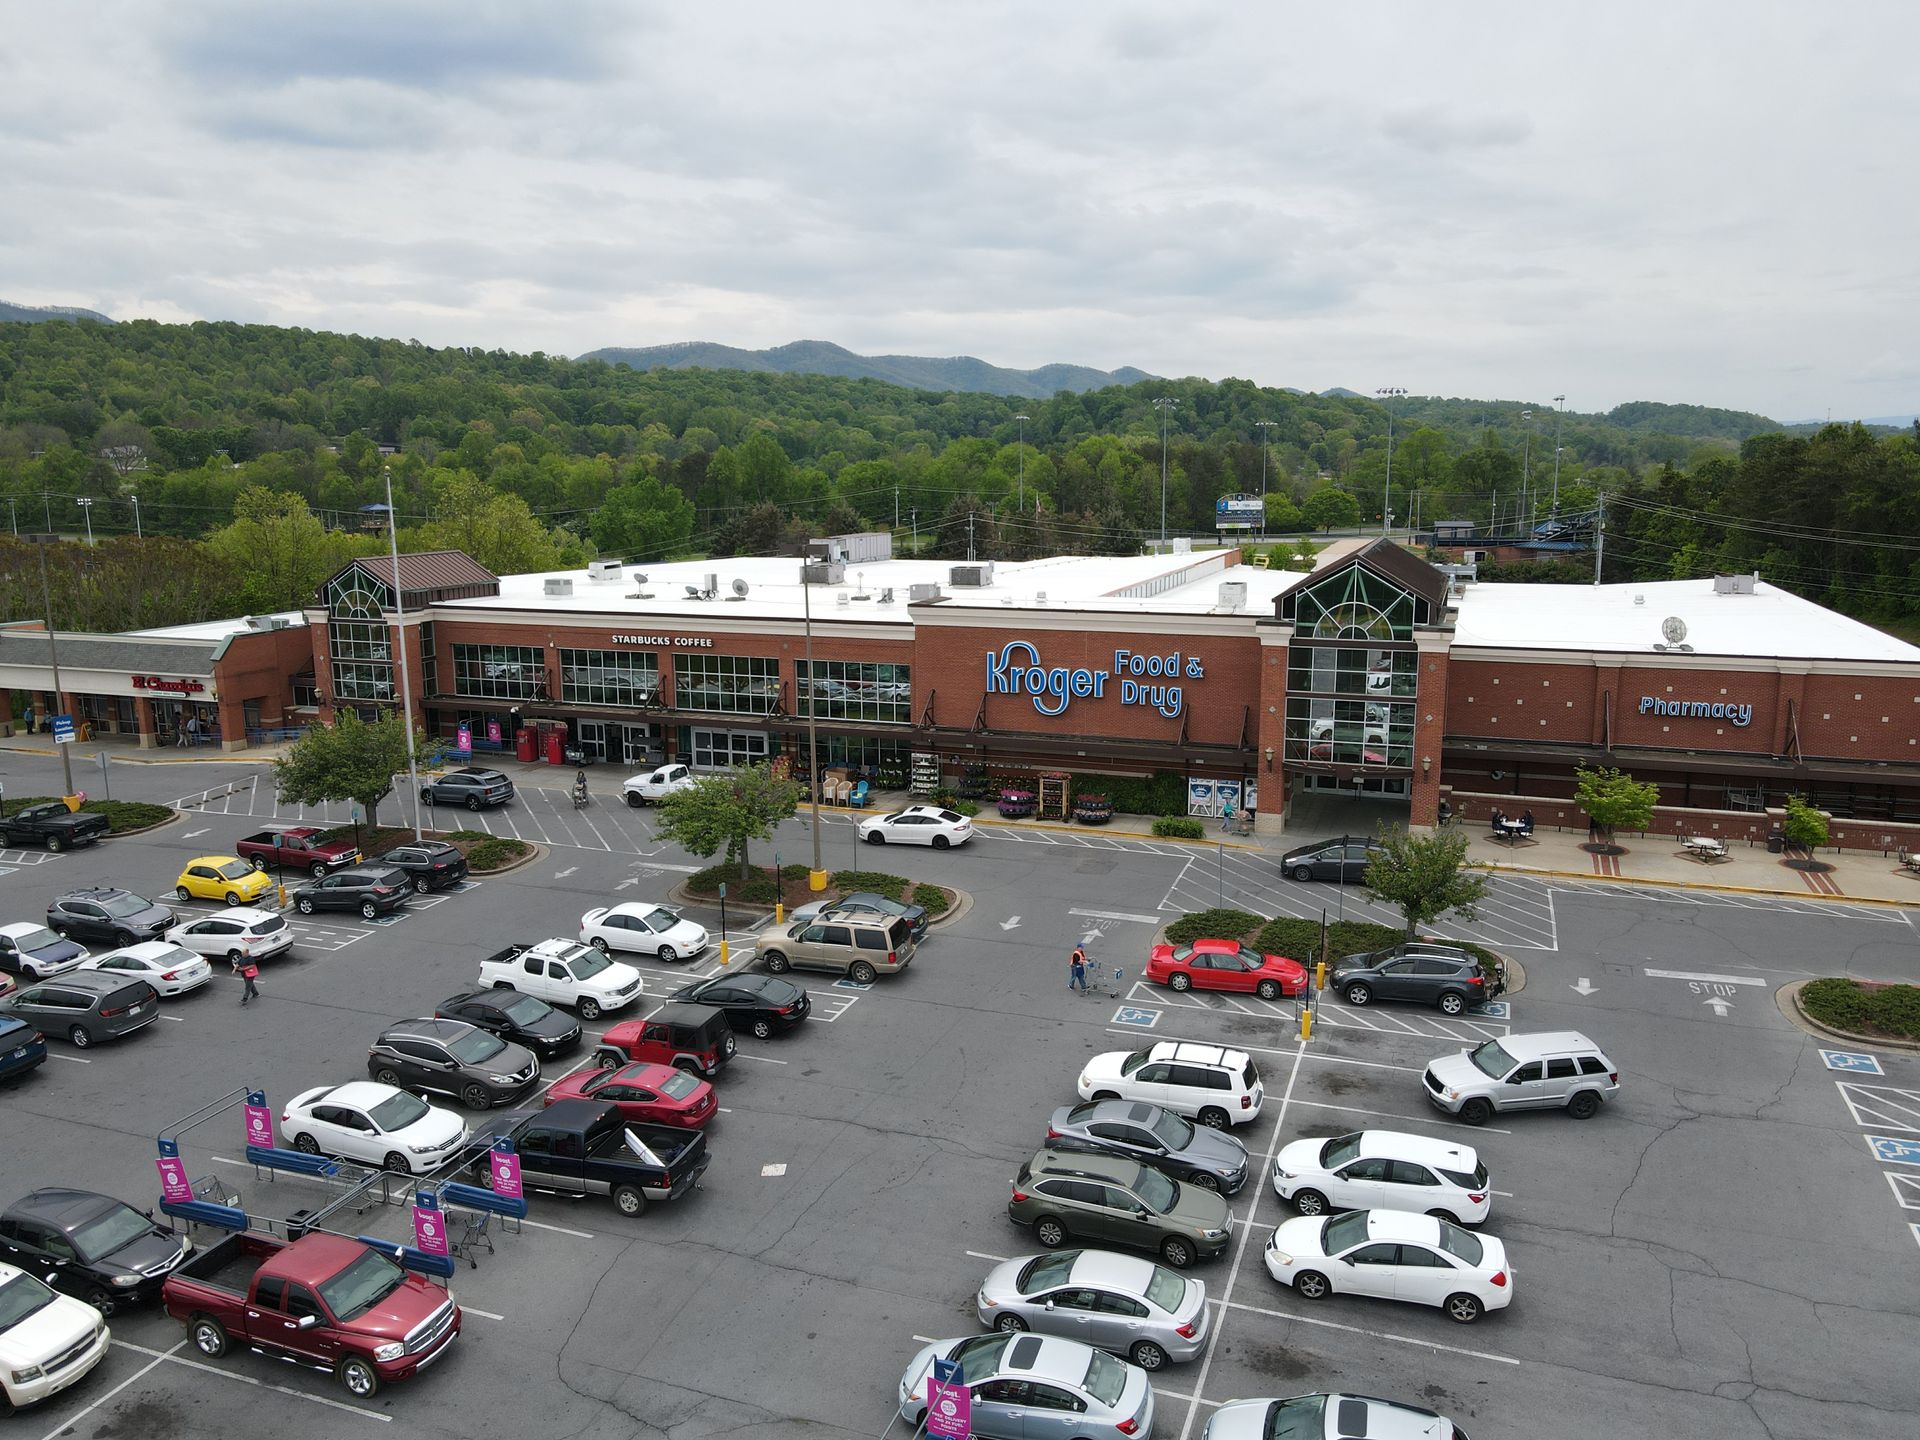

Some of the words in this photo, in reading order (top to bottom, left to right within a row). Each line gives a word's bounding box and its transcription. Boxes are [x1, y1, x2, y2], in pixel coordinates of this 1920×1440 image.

[612, 635, 670, 645] STARBUCKS
[674, 637, 712, 647] COFFEE
[986, 640, 1109, 716] Kroger
[1114, 649, 1180, 677] Food
[1185, 657, 1204, 679] &
[1121, 680, 1182, 718] Drug
[1640, 696, 1752, 726] Pharmacy
[1081, 918, 1121, 930] STOP
[1688, 981, 1736, 997] STOP
